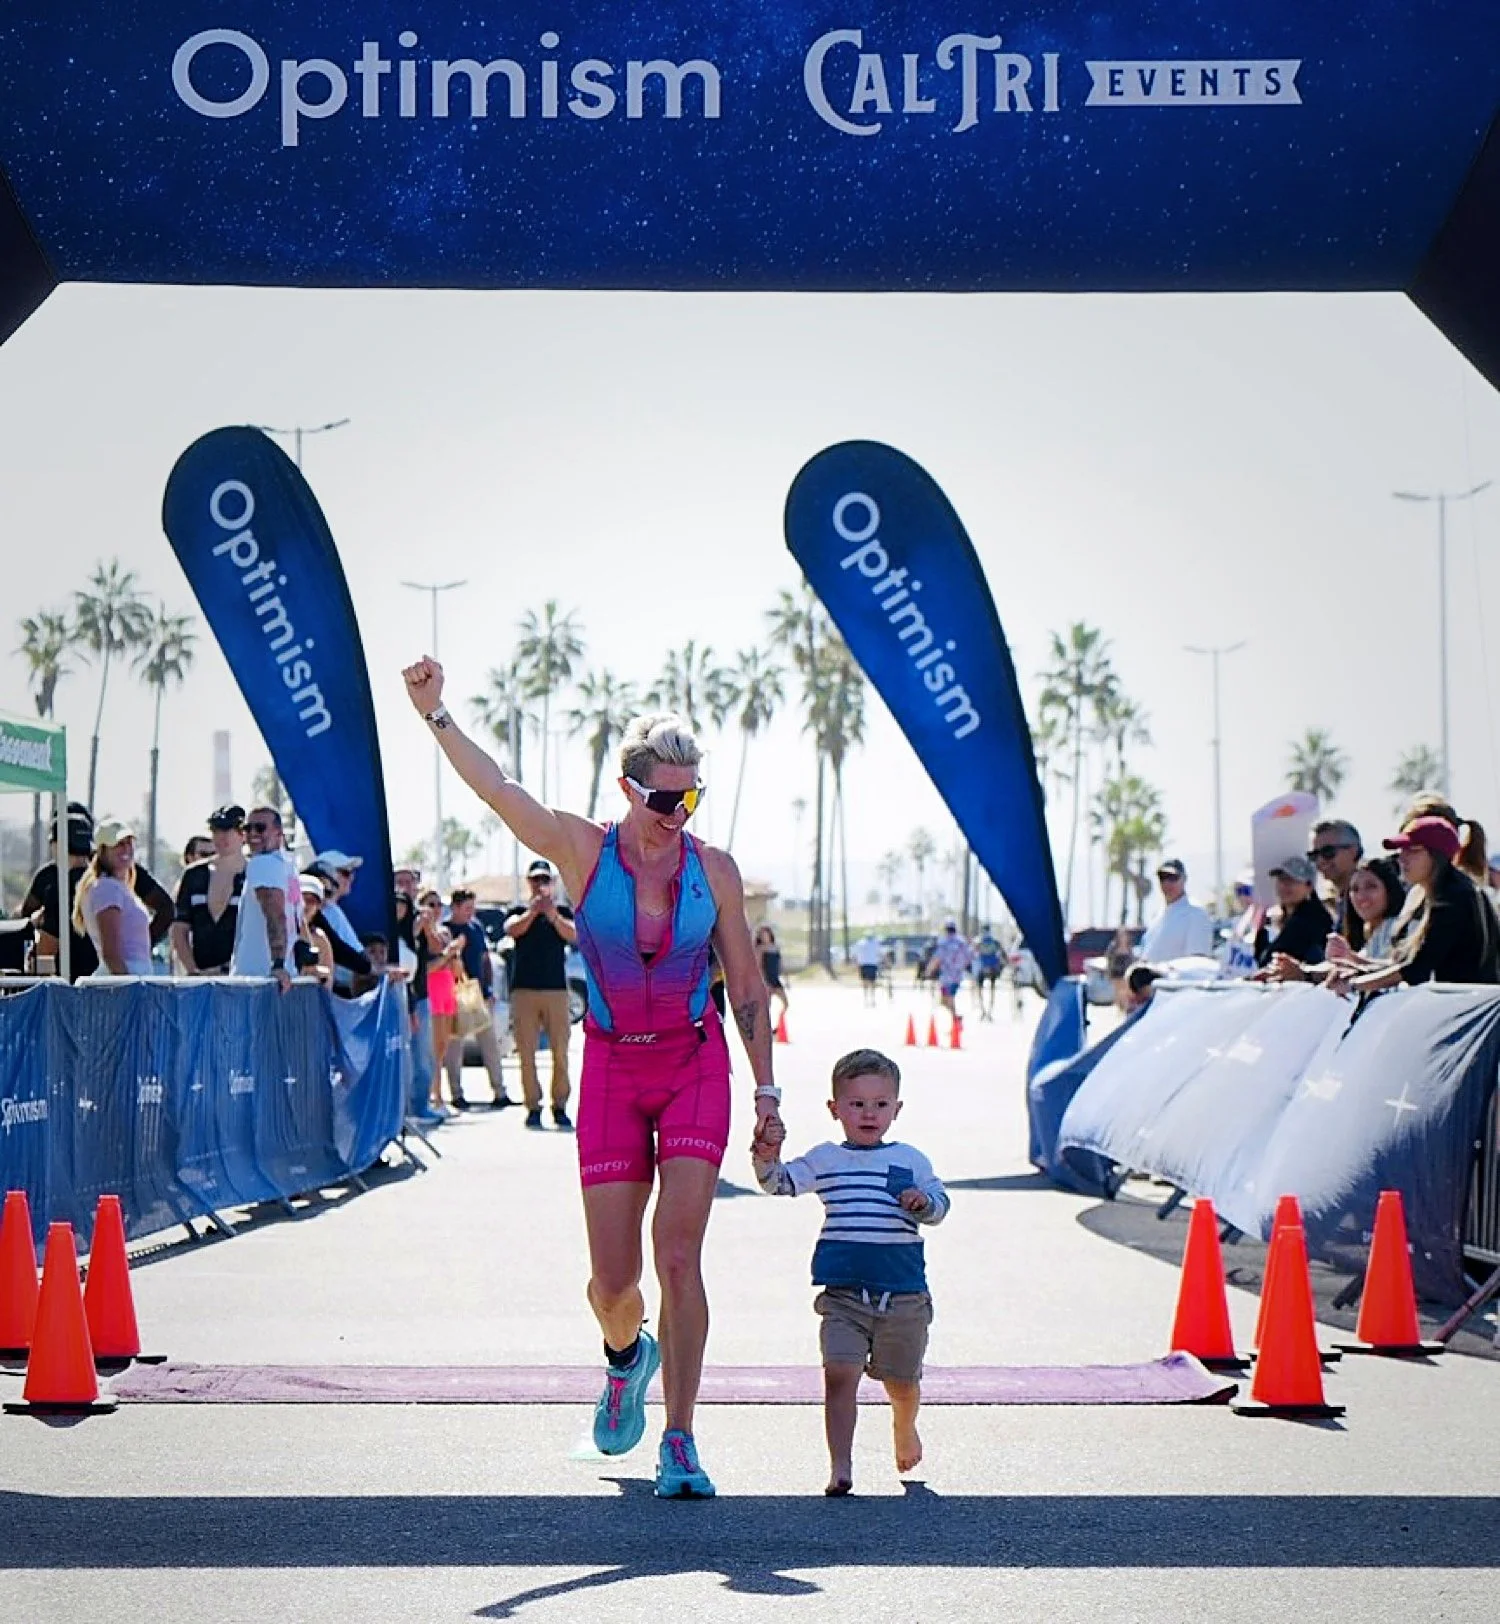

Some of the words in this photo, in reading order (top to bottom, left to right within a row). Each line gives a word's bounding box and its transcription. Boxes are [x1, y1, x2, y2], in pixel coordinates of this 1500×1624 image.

[171, 28, 721, 147] Optimism
[1108, 66, 1283, 97] EVENTS
[209, 479, 332, 738] Optimism
[832, 491, 981, 740] Optimism
